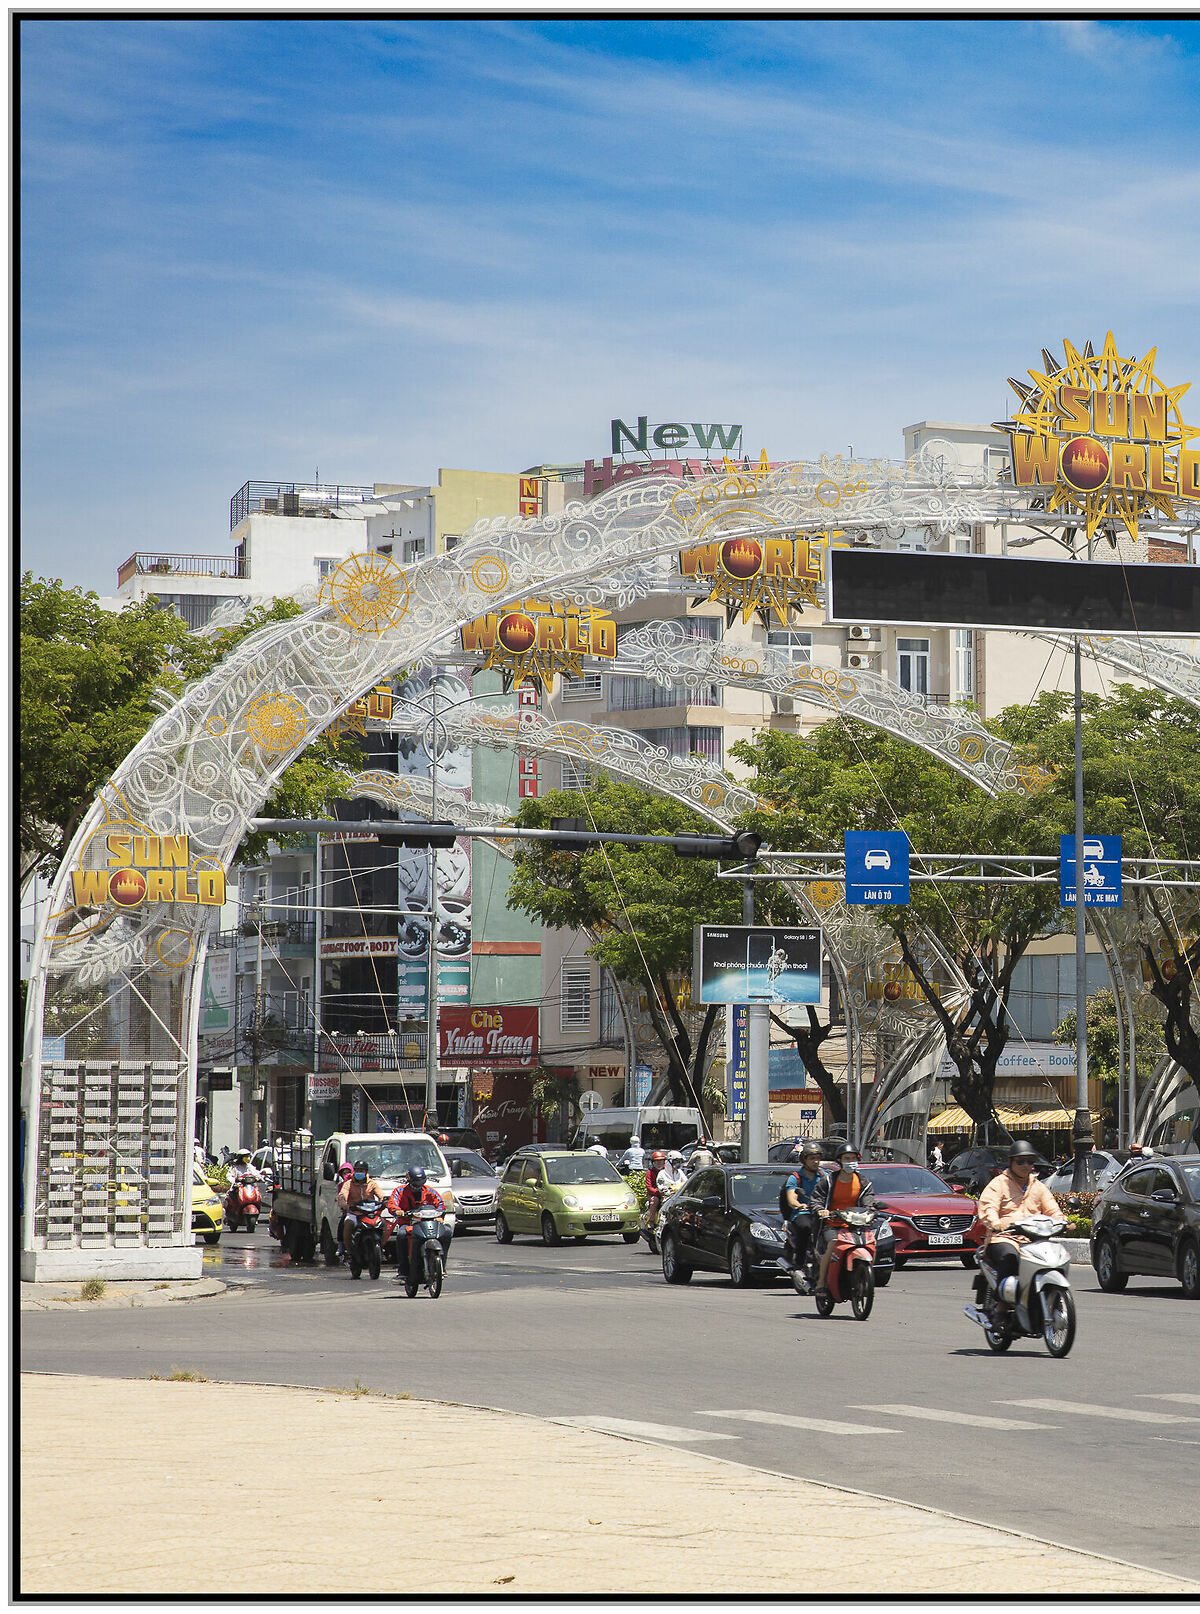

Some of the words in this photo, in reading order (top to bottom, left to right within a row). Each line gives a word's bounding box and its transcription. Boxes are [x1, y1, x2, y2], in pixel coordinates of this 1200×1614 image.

[1056, 385, 1168, 441] SUN
[611, 416, 743, 455] New
[678, 537, 825, 583] WORL
[461, 612, 618, 660] WORLD
[106, 834, 190, 868] SUN
[71, 868, 227, 907] WORLD
[864, 889, 877, 900] LÀN
[877, 889, 883, 900] Ô
[884, 889, 892, 900] TÔ
[1096, 894, 1105, 903] XE
[345, 941, 365, 954] FOOT
[370, 940, 397, 953] BODY
[726, 960, 746, 970] phóng
[471, 1009, 504, 1028] Chè
[486, 1026, 534, 1065] Trang
[997, 1054, 1036, 1067] Coffee
[589, 1066, 621, 1078] NEW
[309, 1076, 340, 1088] Massage
